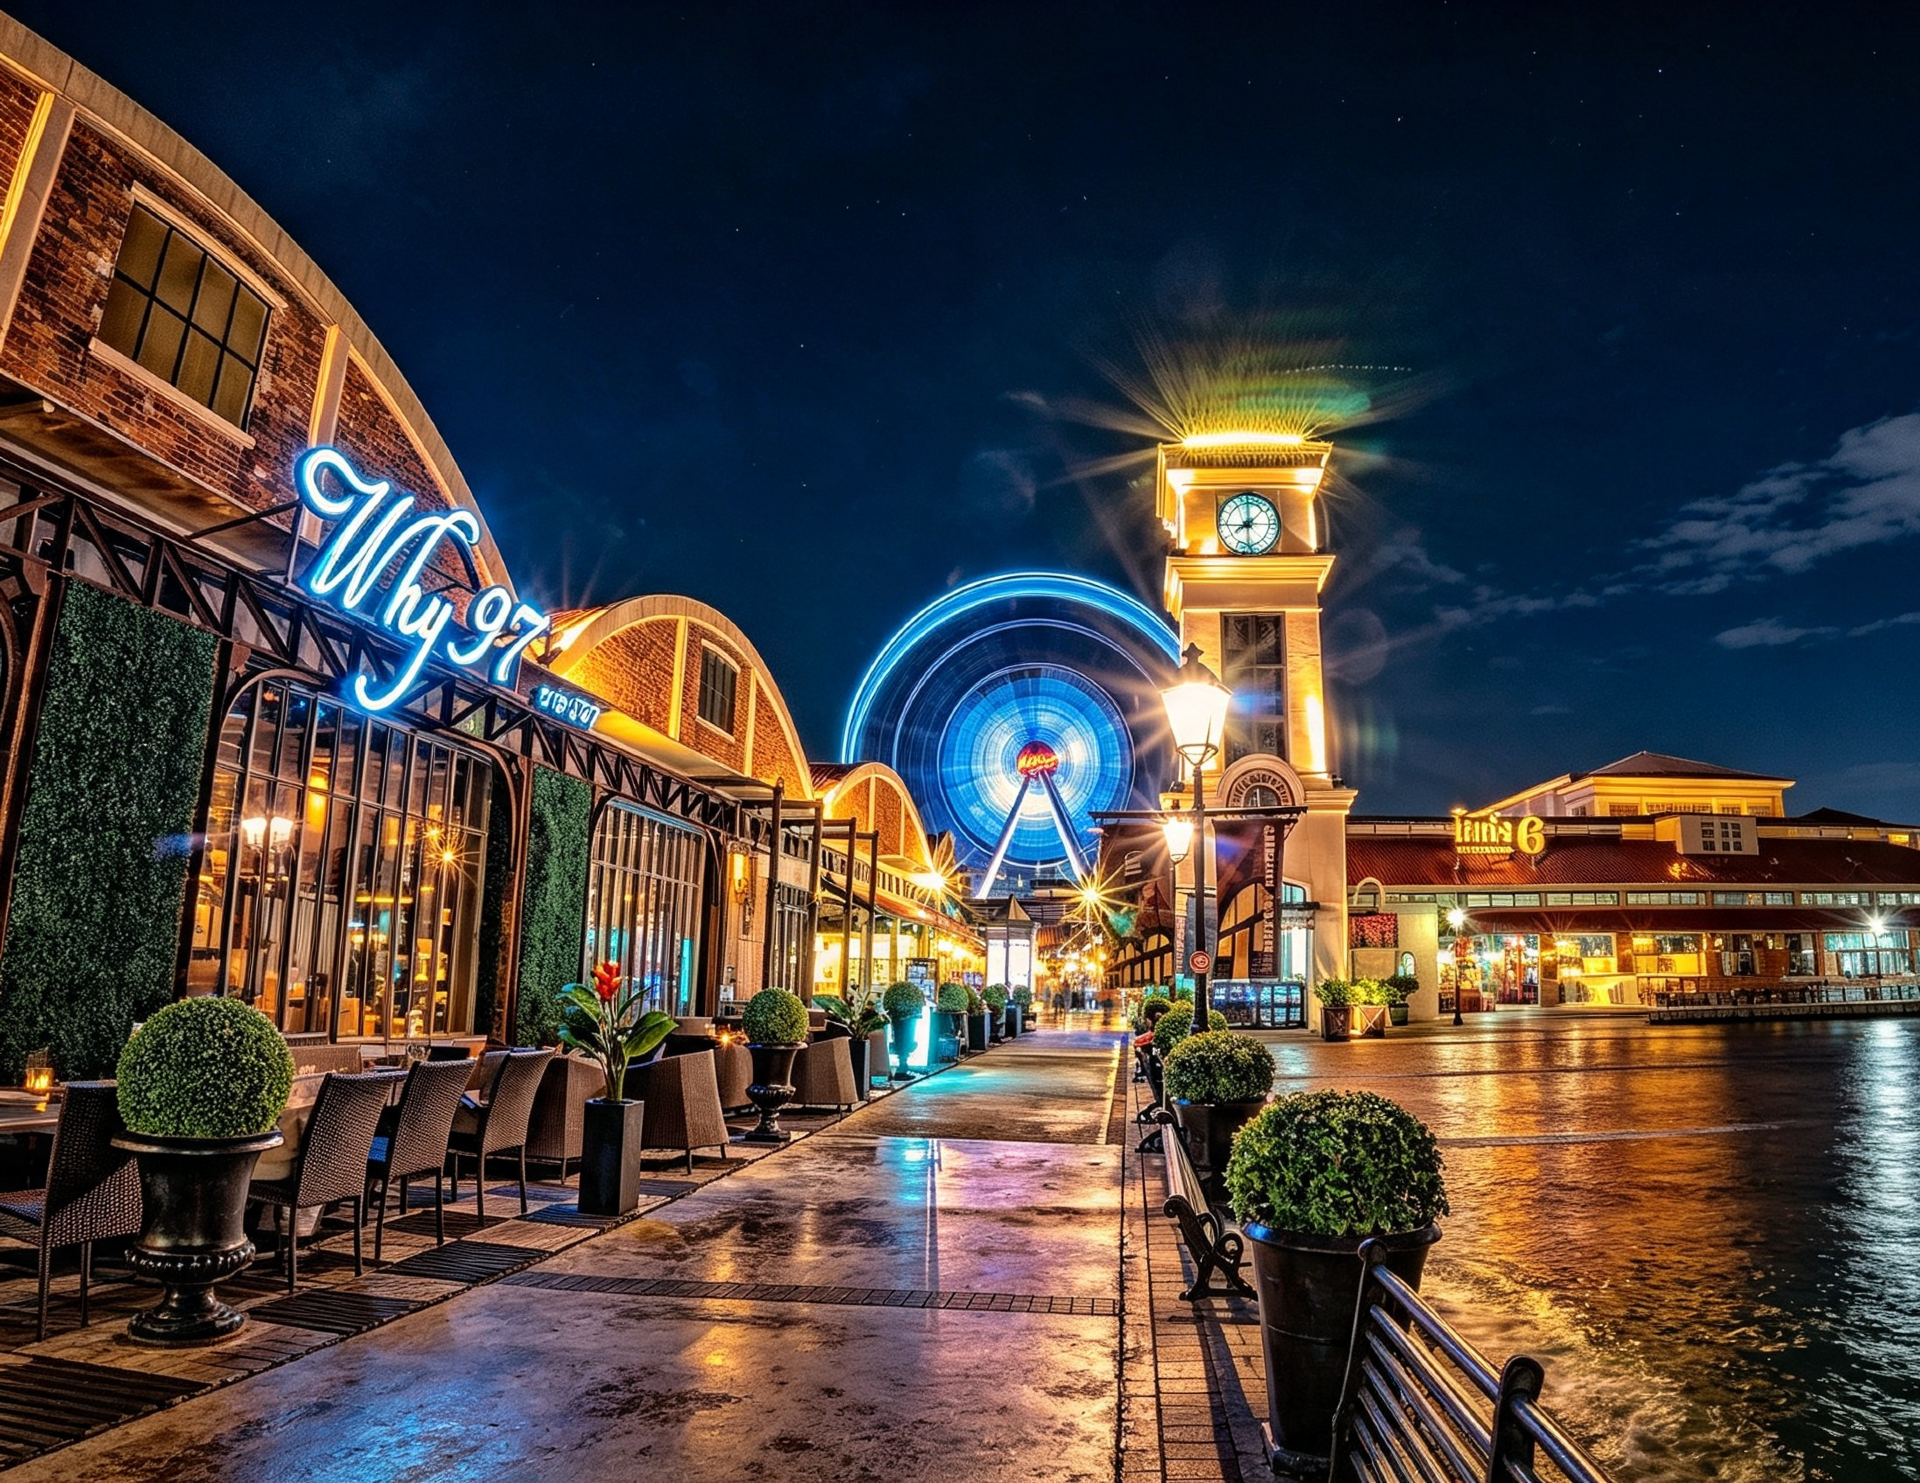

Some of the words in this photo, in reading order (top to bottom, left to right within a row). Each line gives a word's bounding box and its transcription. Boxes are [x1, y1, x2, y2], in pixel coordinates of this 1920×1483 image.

[304, 447, 481, 711] Why
[447, 586, 552, 683] 97
[1517, 815, 1546, 855] 6
